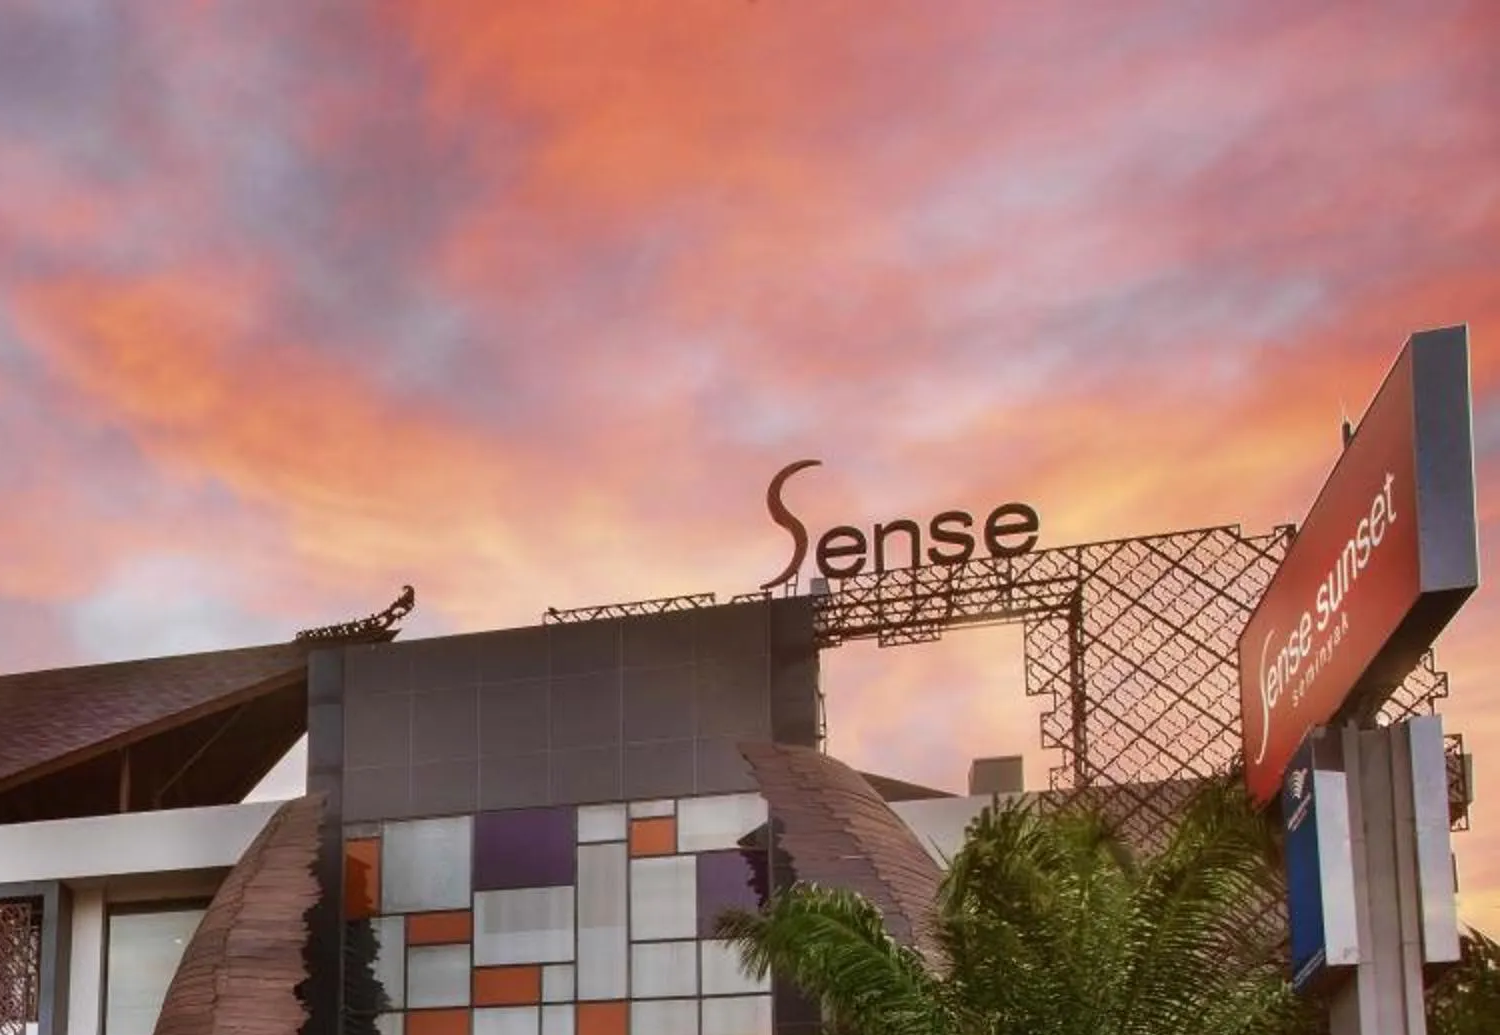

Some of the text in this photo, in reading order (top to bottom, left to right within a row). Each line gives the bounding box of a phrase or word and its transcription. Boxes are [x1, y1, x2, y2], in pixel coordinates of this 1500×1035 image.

[759, 459, 1039, 591] Sense
[1255, 472, 1397, 765] Sense sunset
